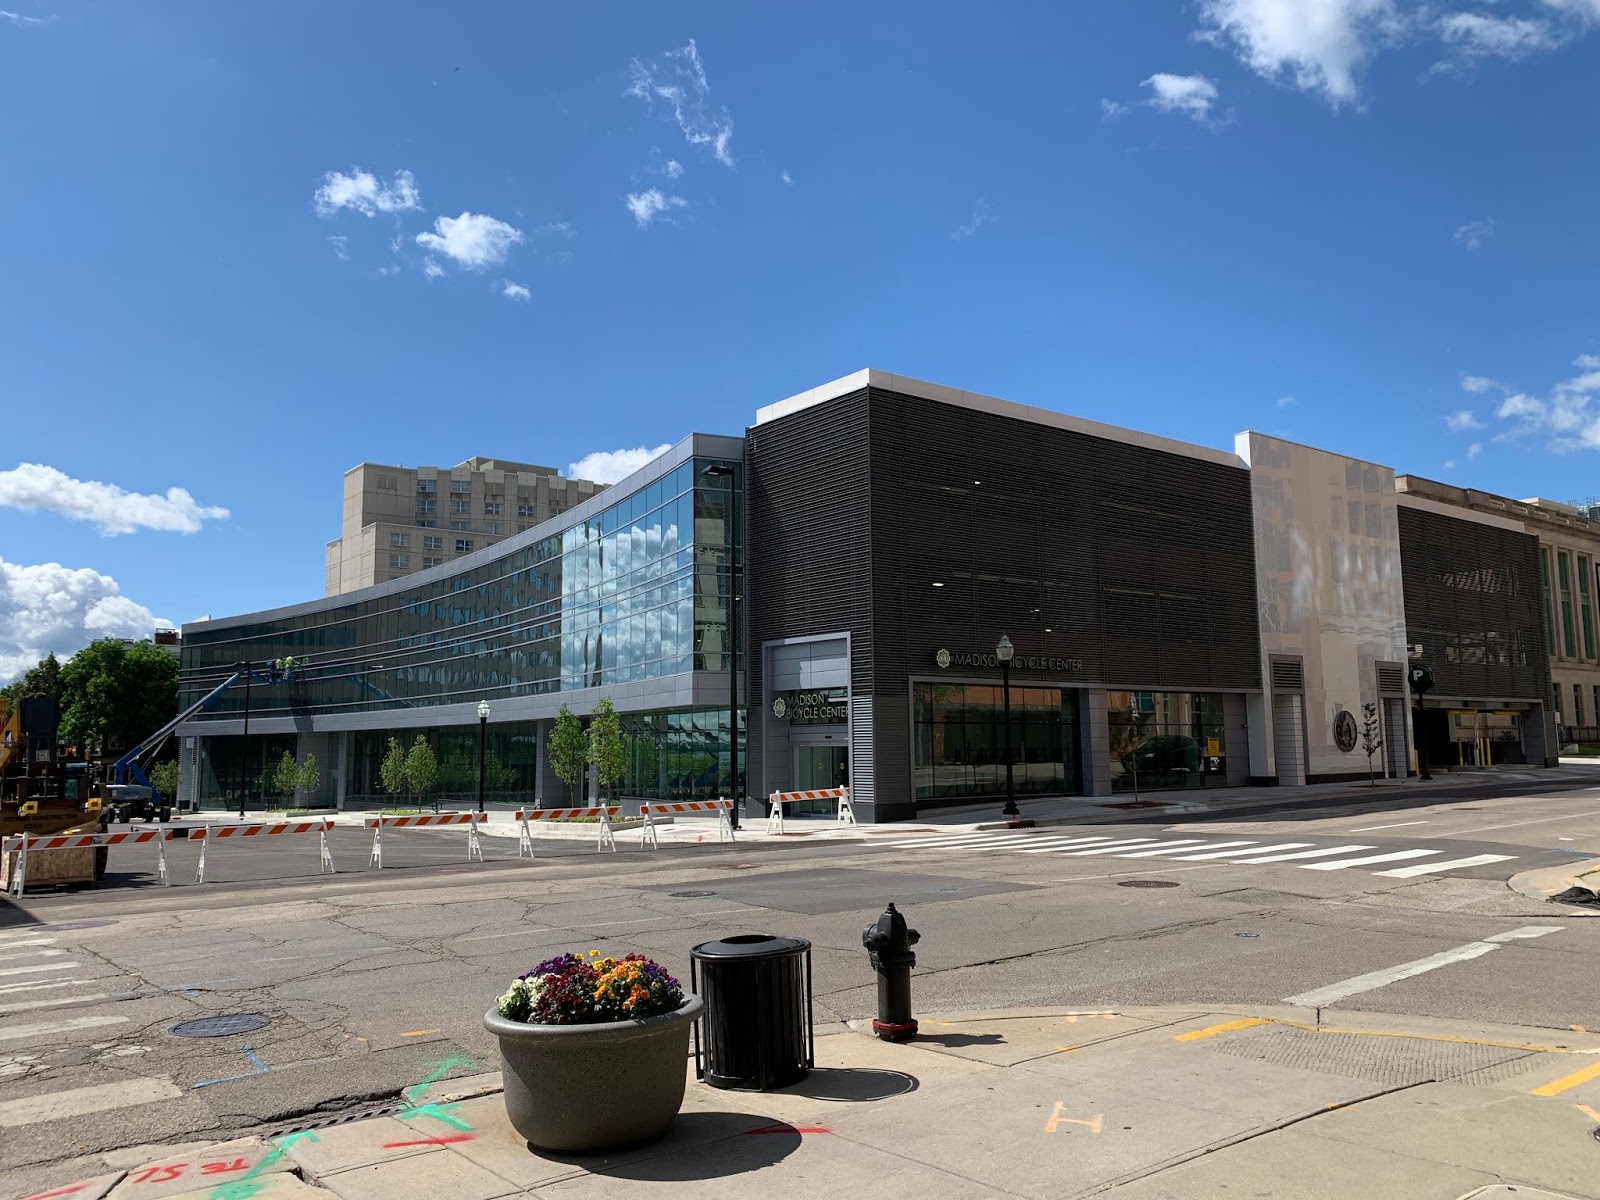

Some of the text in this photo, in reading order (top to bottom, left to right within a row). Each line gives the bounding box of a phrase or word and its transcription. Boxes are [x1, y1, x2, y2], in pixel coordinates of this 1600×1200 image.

[1049, 658, 1083, 671] CENTER
[1413, 669, 1424, 681] P
[787, 693, 825, 706] MADISON
[787, 707, 818, 719] BICYCLE
